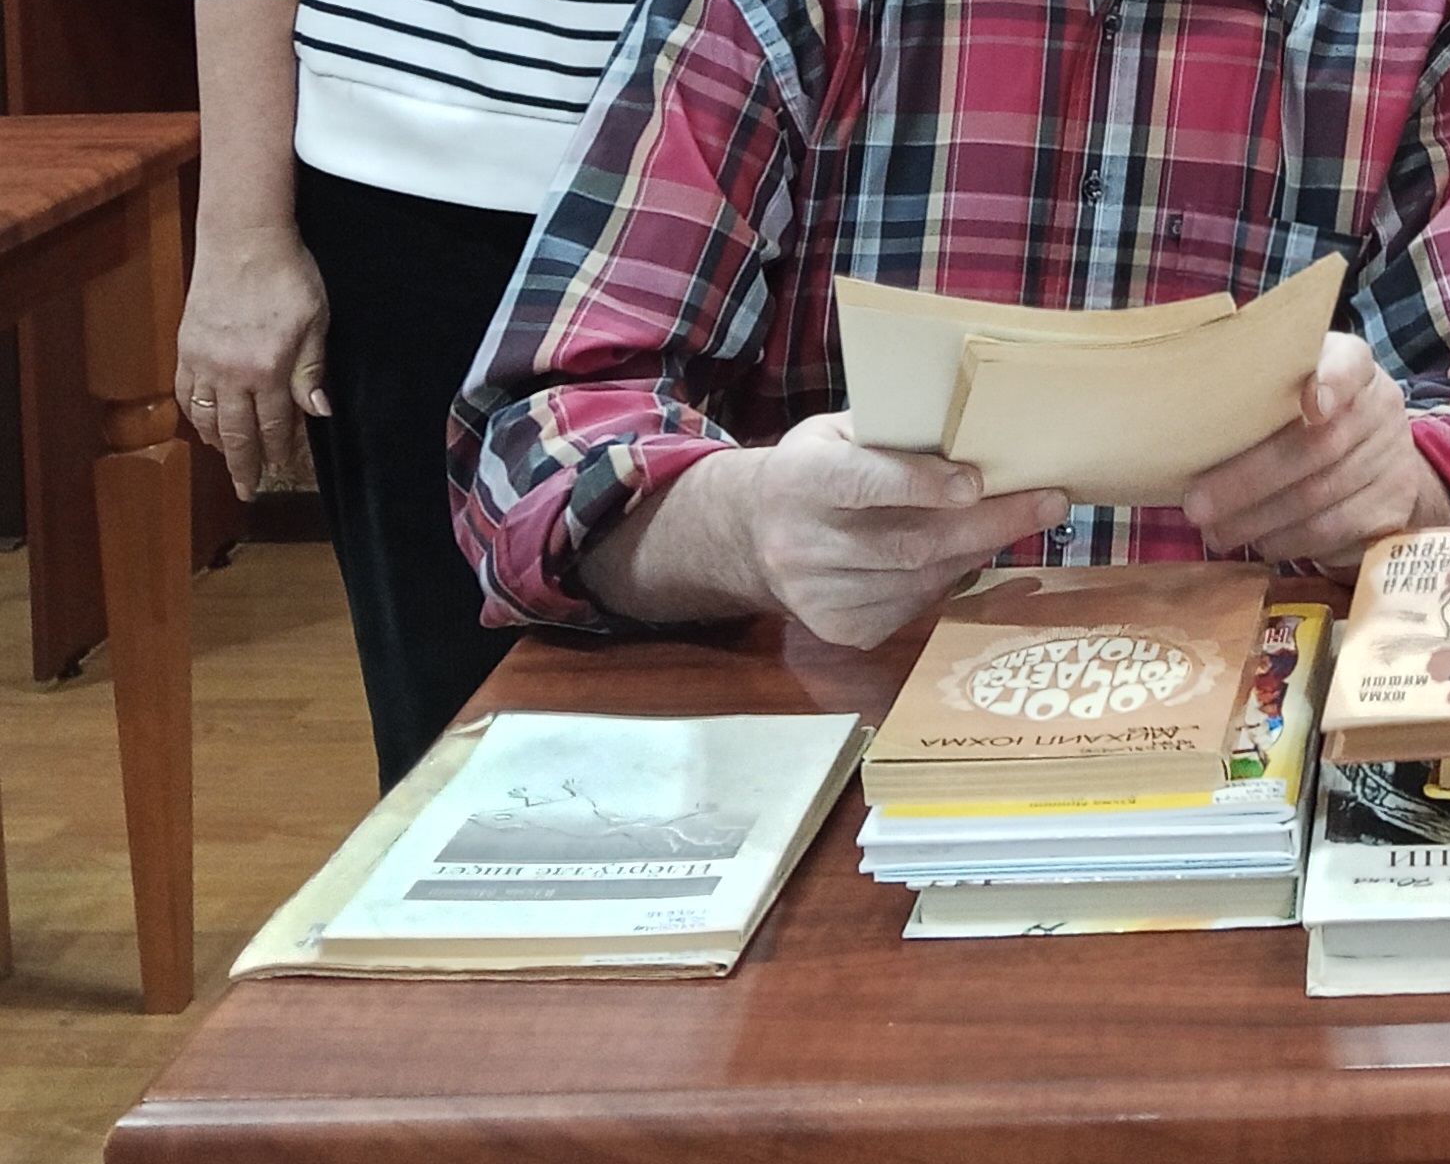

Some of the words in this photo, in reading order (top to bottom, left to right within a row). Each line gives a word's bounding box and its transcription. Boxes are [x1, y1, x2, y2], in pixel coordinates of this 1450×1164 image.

[991, 636, 1160, 671] ПОЛДЕНЬ
[972, 659, 1188, 689] КОНЧАЕТСЯ
[1361, 675, 1428, 687] МИШШИ
[971, 678, 1173, 721] ДОРОГА
[1359, 691, 1406, 703] ЮХМА
[920, 736, 1024, 748] ЮХМА
